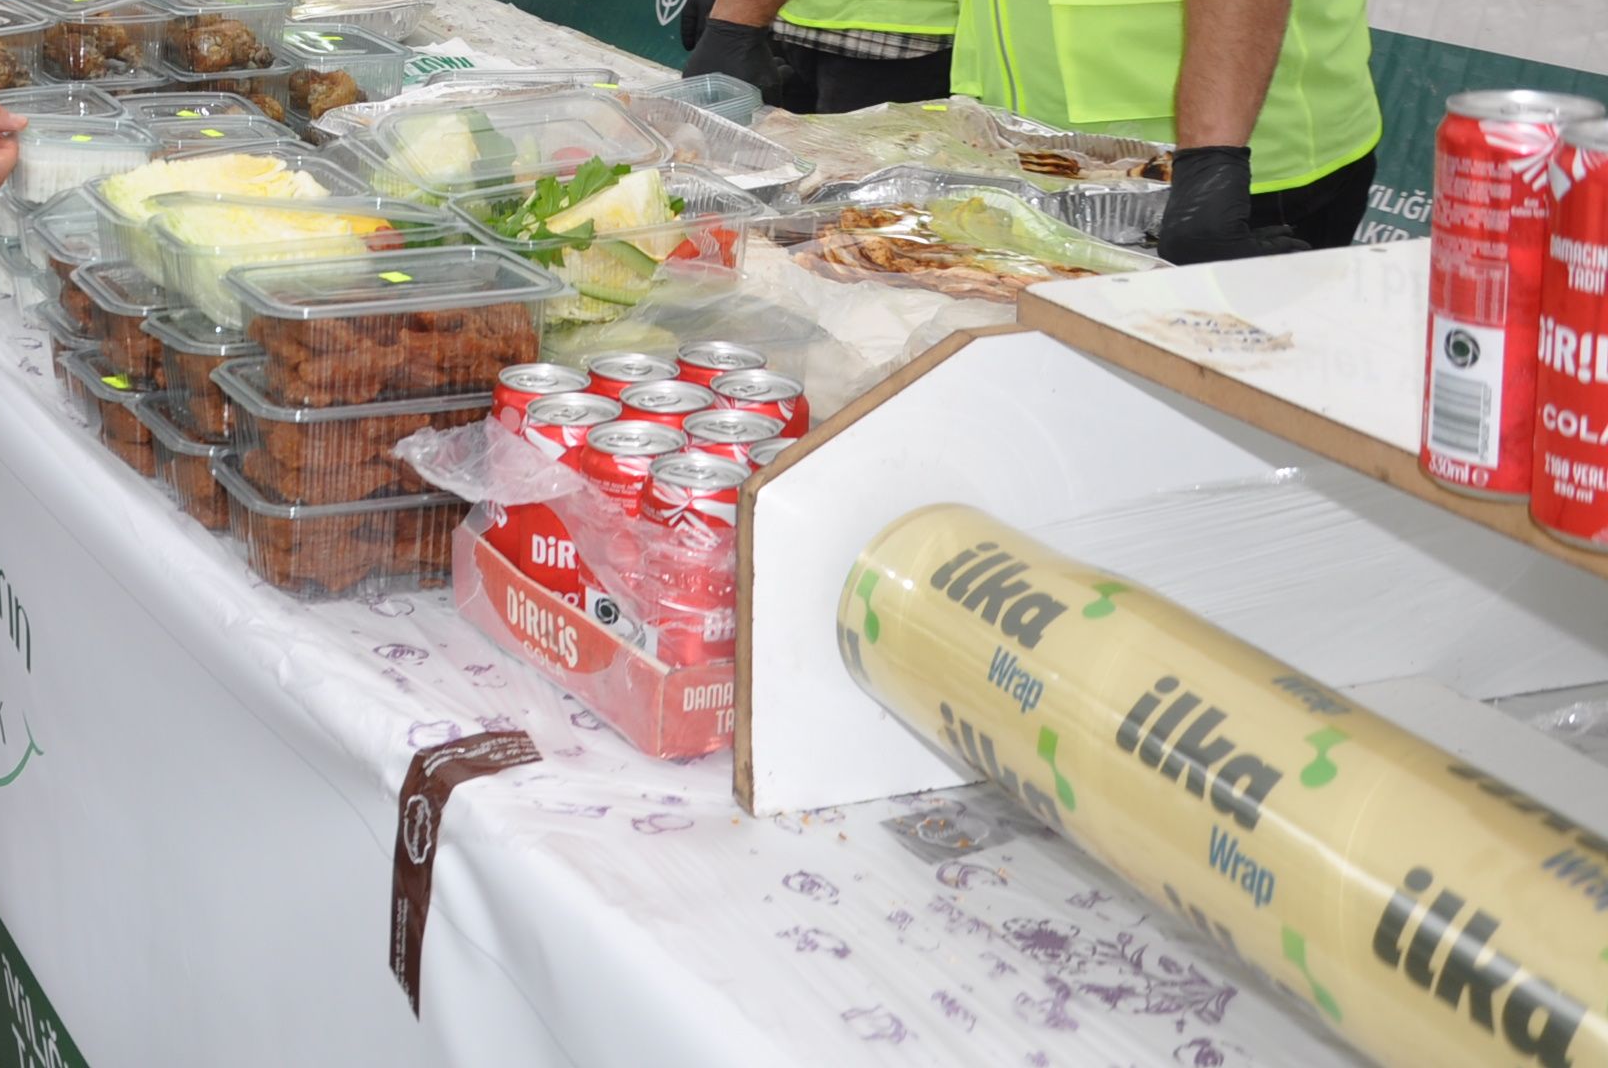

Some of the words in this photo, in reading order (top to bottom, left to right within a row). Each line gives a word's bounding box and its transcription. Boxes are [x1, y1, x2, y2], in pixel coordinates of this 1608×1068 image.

[930, 541, 1070, 651] ilka
[986, 644, 1044, 714] Wrap
[1115, 674, 1284, 833] ilka
[1208, 824, 1276, 909] Wrap
[1372, 865, 1589, 1068] ilka
